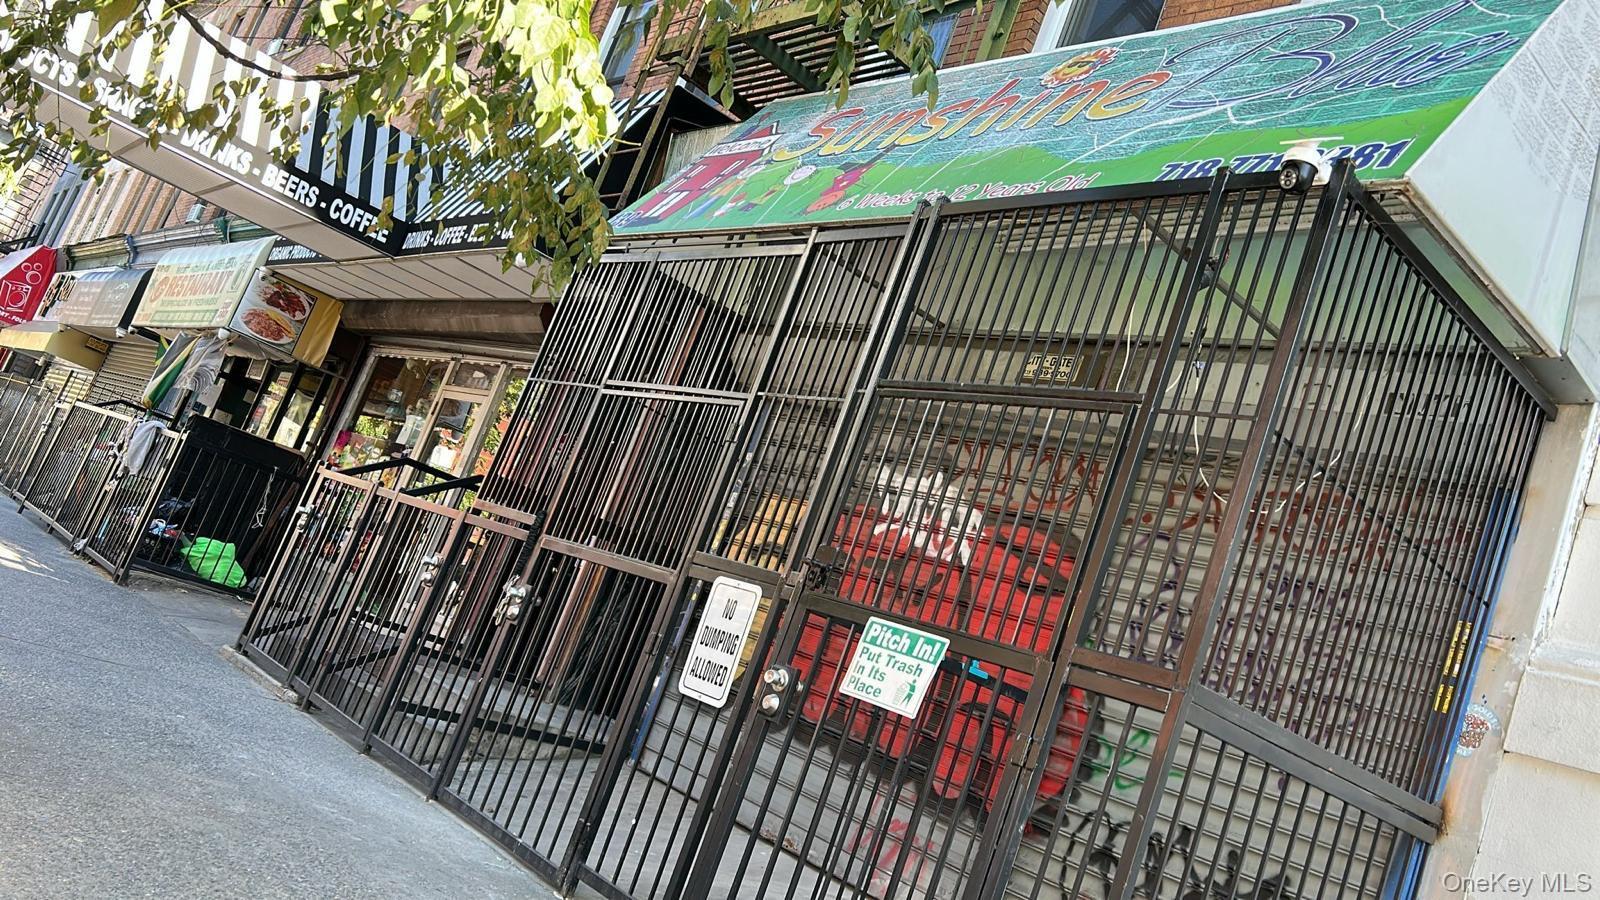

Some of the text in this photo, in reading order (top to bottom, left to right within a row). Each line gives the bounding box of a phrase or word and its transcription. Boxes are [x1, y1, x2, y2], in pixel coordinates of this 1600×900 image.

[772, 0, 1521, 163] Sunshine Blue
[179, 124, 254, 175] DRINKS
[261, 163, 320, 208] BEERS
[329, 198, 389, 244] COFFEE
[854, 188, 921, 210] Weeks
[974, 180, 1047, 201] Years
[1042, 171, 1102, 193] Old
[402, 229, 433, 250] DRINKS
[164, 270, 235, 298] RESTAURANT
[722, 598, 738, 620] NO
[699, 626, 740, 656] DUMPING
[865, 620, 942, 662] Pitch In!
[689, 655, 728, 688] ALLOWED
[853, 660, 887, 684] In Its
[858, 646, 924, 678] Put Trash
[847, 674, 882, 699] Place
